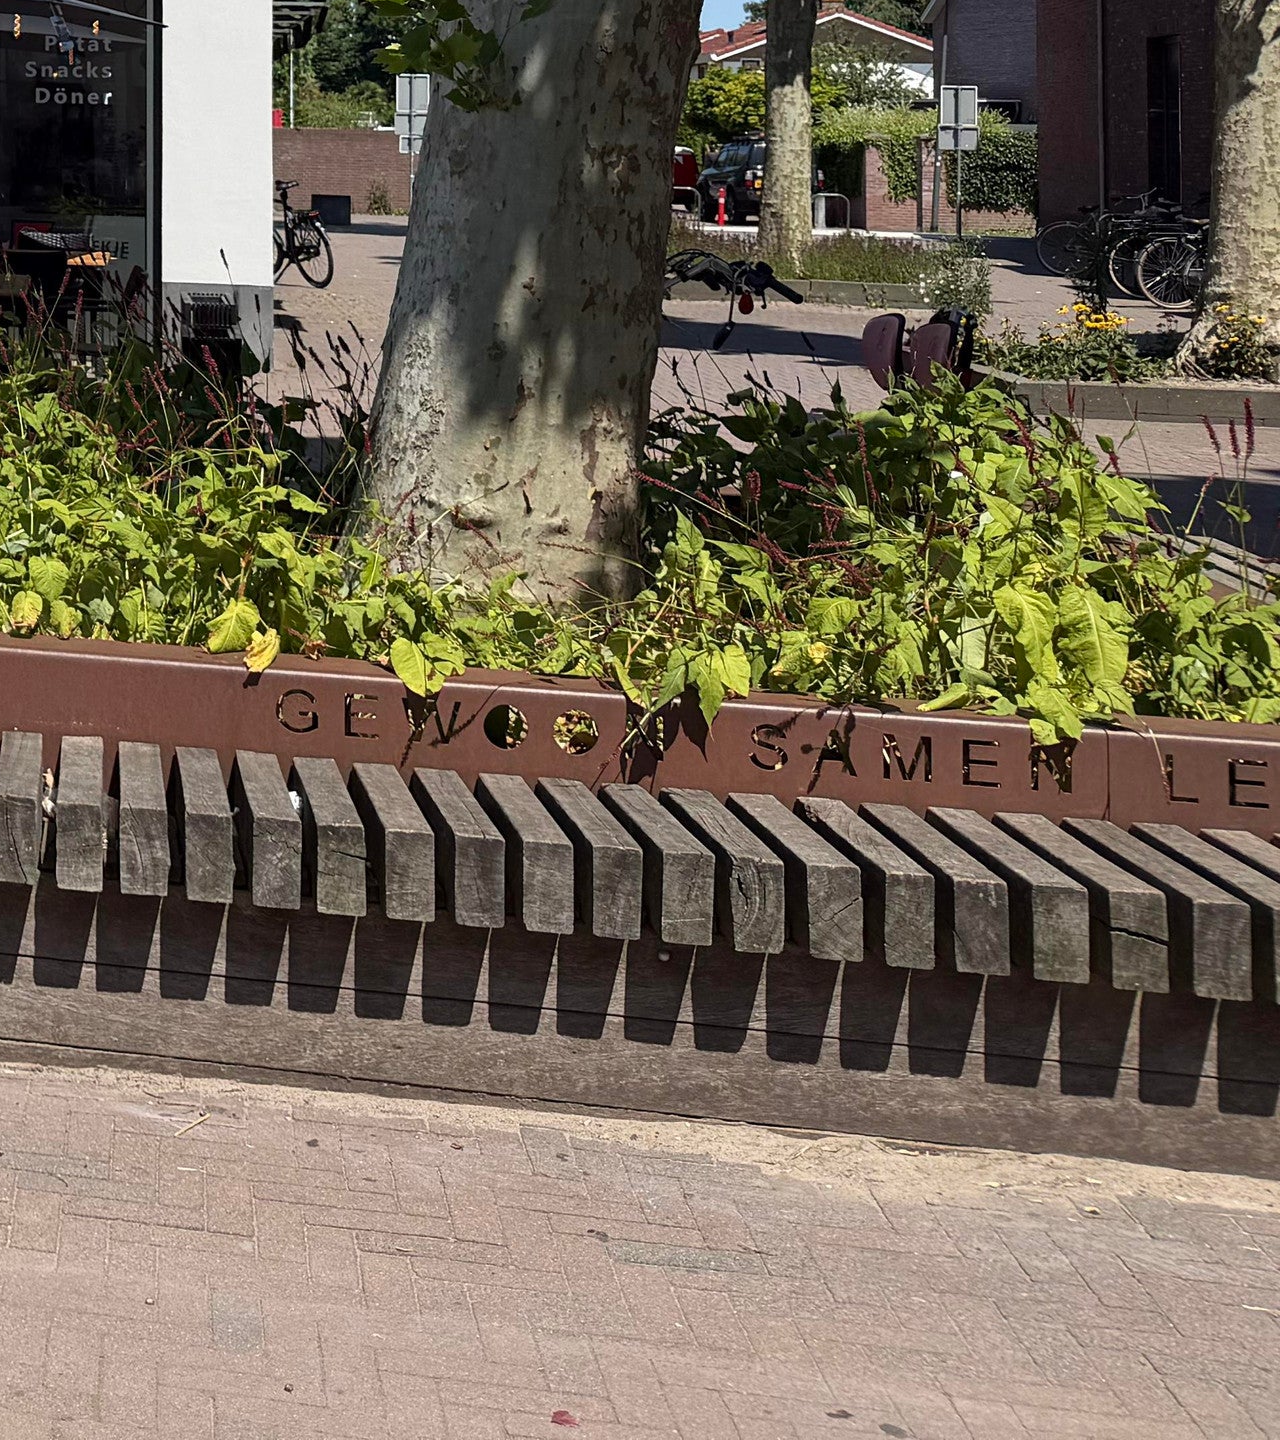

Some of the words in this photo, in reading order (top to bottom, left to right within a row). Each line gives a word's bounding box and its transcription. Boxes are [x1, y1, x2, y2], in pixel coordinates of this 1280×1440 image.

[44, 35, 112, 53] Ptat
[25, 61, 112, 78] Snacks
[35, 87, 113, 105] Döner
[747, 723, 1076, 794] SAMEN
